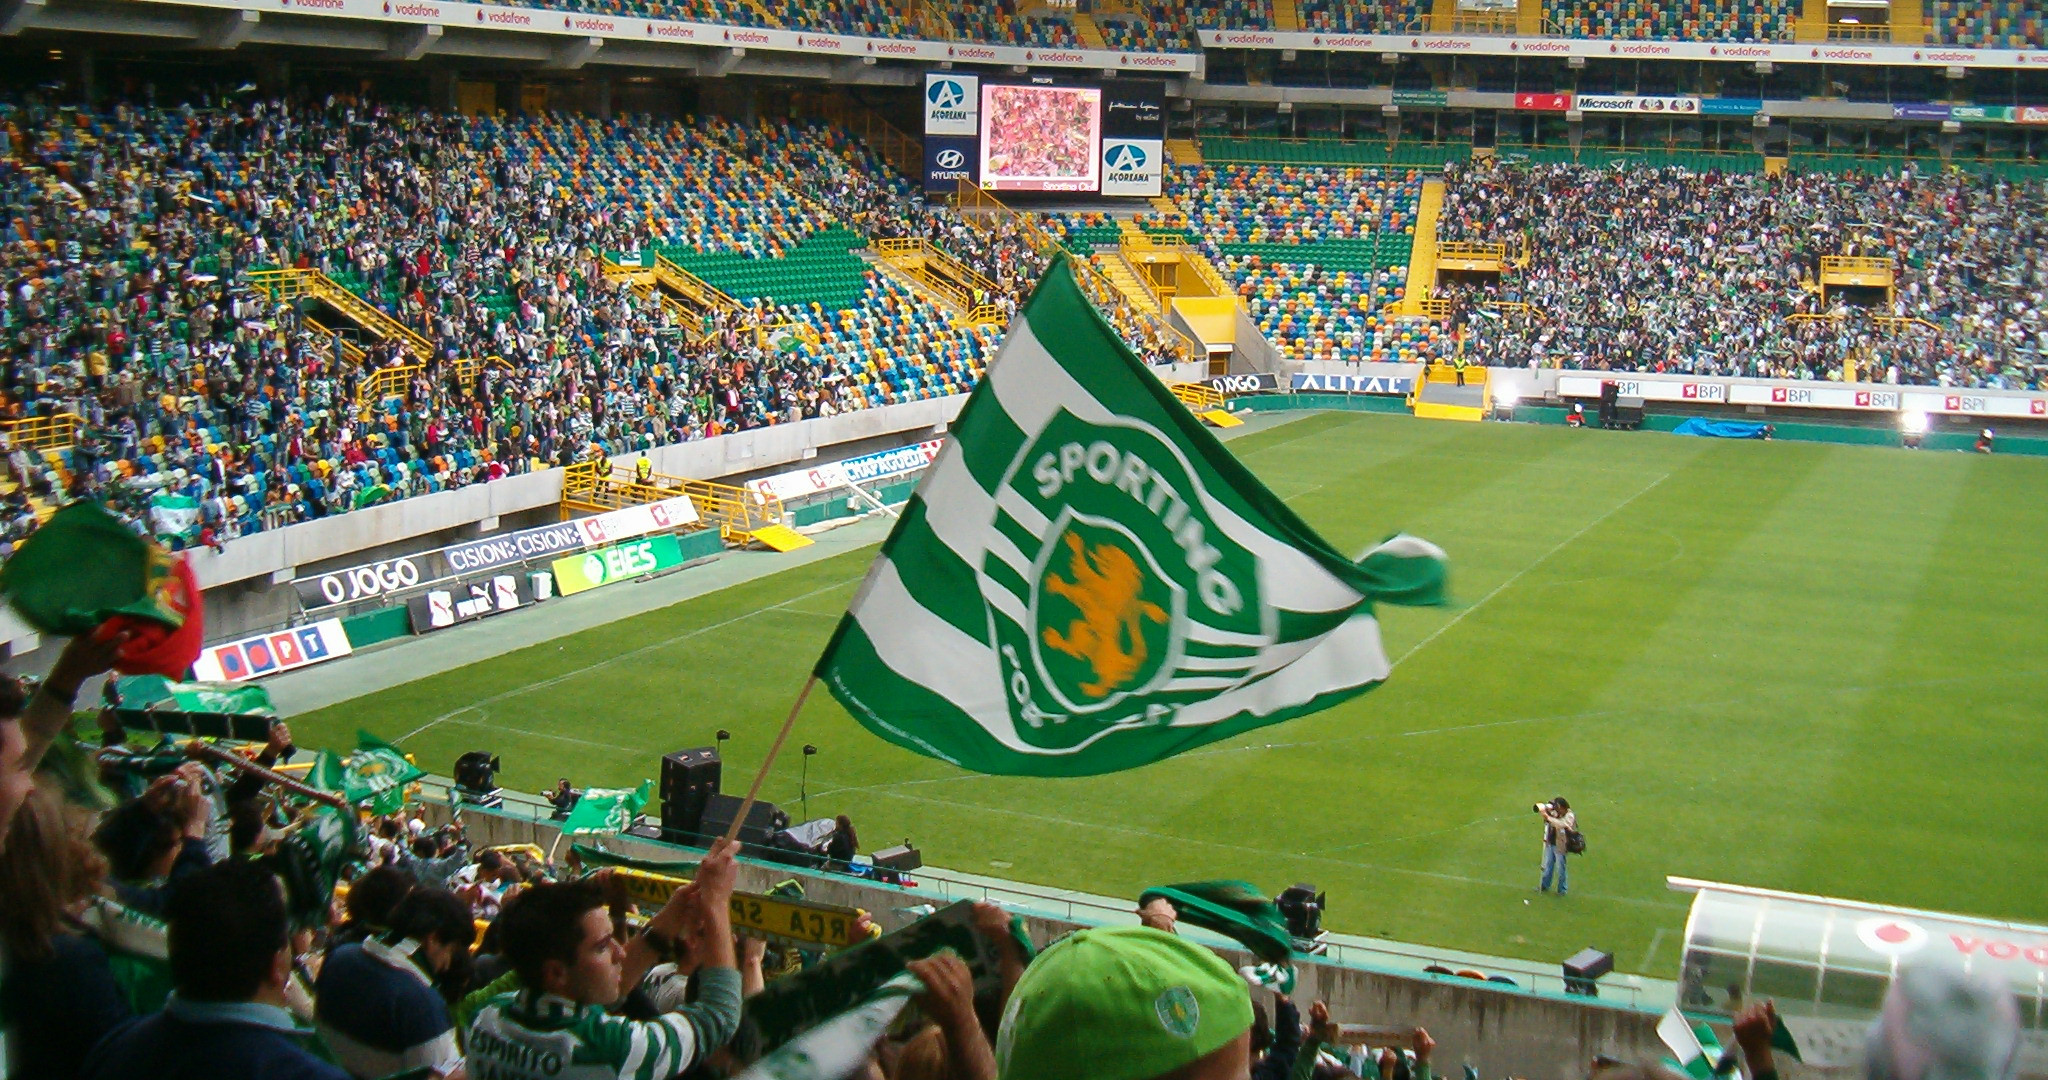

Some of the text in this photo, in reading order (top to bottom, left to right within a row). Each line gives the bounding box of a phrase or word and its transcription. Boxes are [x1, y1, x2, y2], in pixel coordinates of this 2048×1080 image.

[395, 4, 440, 17] vodafone
[488, 11, 531, 25] vodafone
[575, 19, 615, 31] vodafone
[657, 25, 694, 38] vodafone
[732, 31, 769, 44] vodafone
[807, 37, 841, 49] vodafone
[1227, 34, 1274, 45] vodafone
[1325, 37, 1373, 47] vodafone
[1424, 39, 1471, 49] vodafone
[877, 43, 916, 54] vodafone
[1522, 42, 1570, 52] vodafone
[1622, 44, 1670, 54] vodafone
[1722, 46, 1771, 57] vodafone
[957, 48, 995, 59] vodafone
[1038, 52, 1083, 63] vodafone
[1823, 49, 1873, 59] vodafone
[1926, 51, 1976, 62] vodafone
[1132, 56, 1177, 67] vodafone
[1579, 98, 1633, 109] Microsoft
[1212, 375, 1260, 393] O JOGO
[1698, 385, 1722, 398] BPI
[1788, 389, 1812, 403] BPI
[1871, 393, 1896, 407] BPI
[1962, 396, 1986, 411] BPI
[517, 529, 570, 555] CISION
[449, 543, 504, 571] CISION
[321, 558, 419, 603] O JOGO
